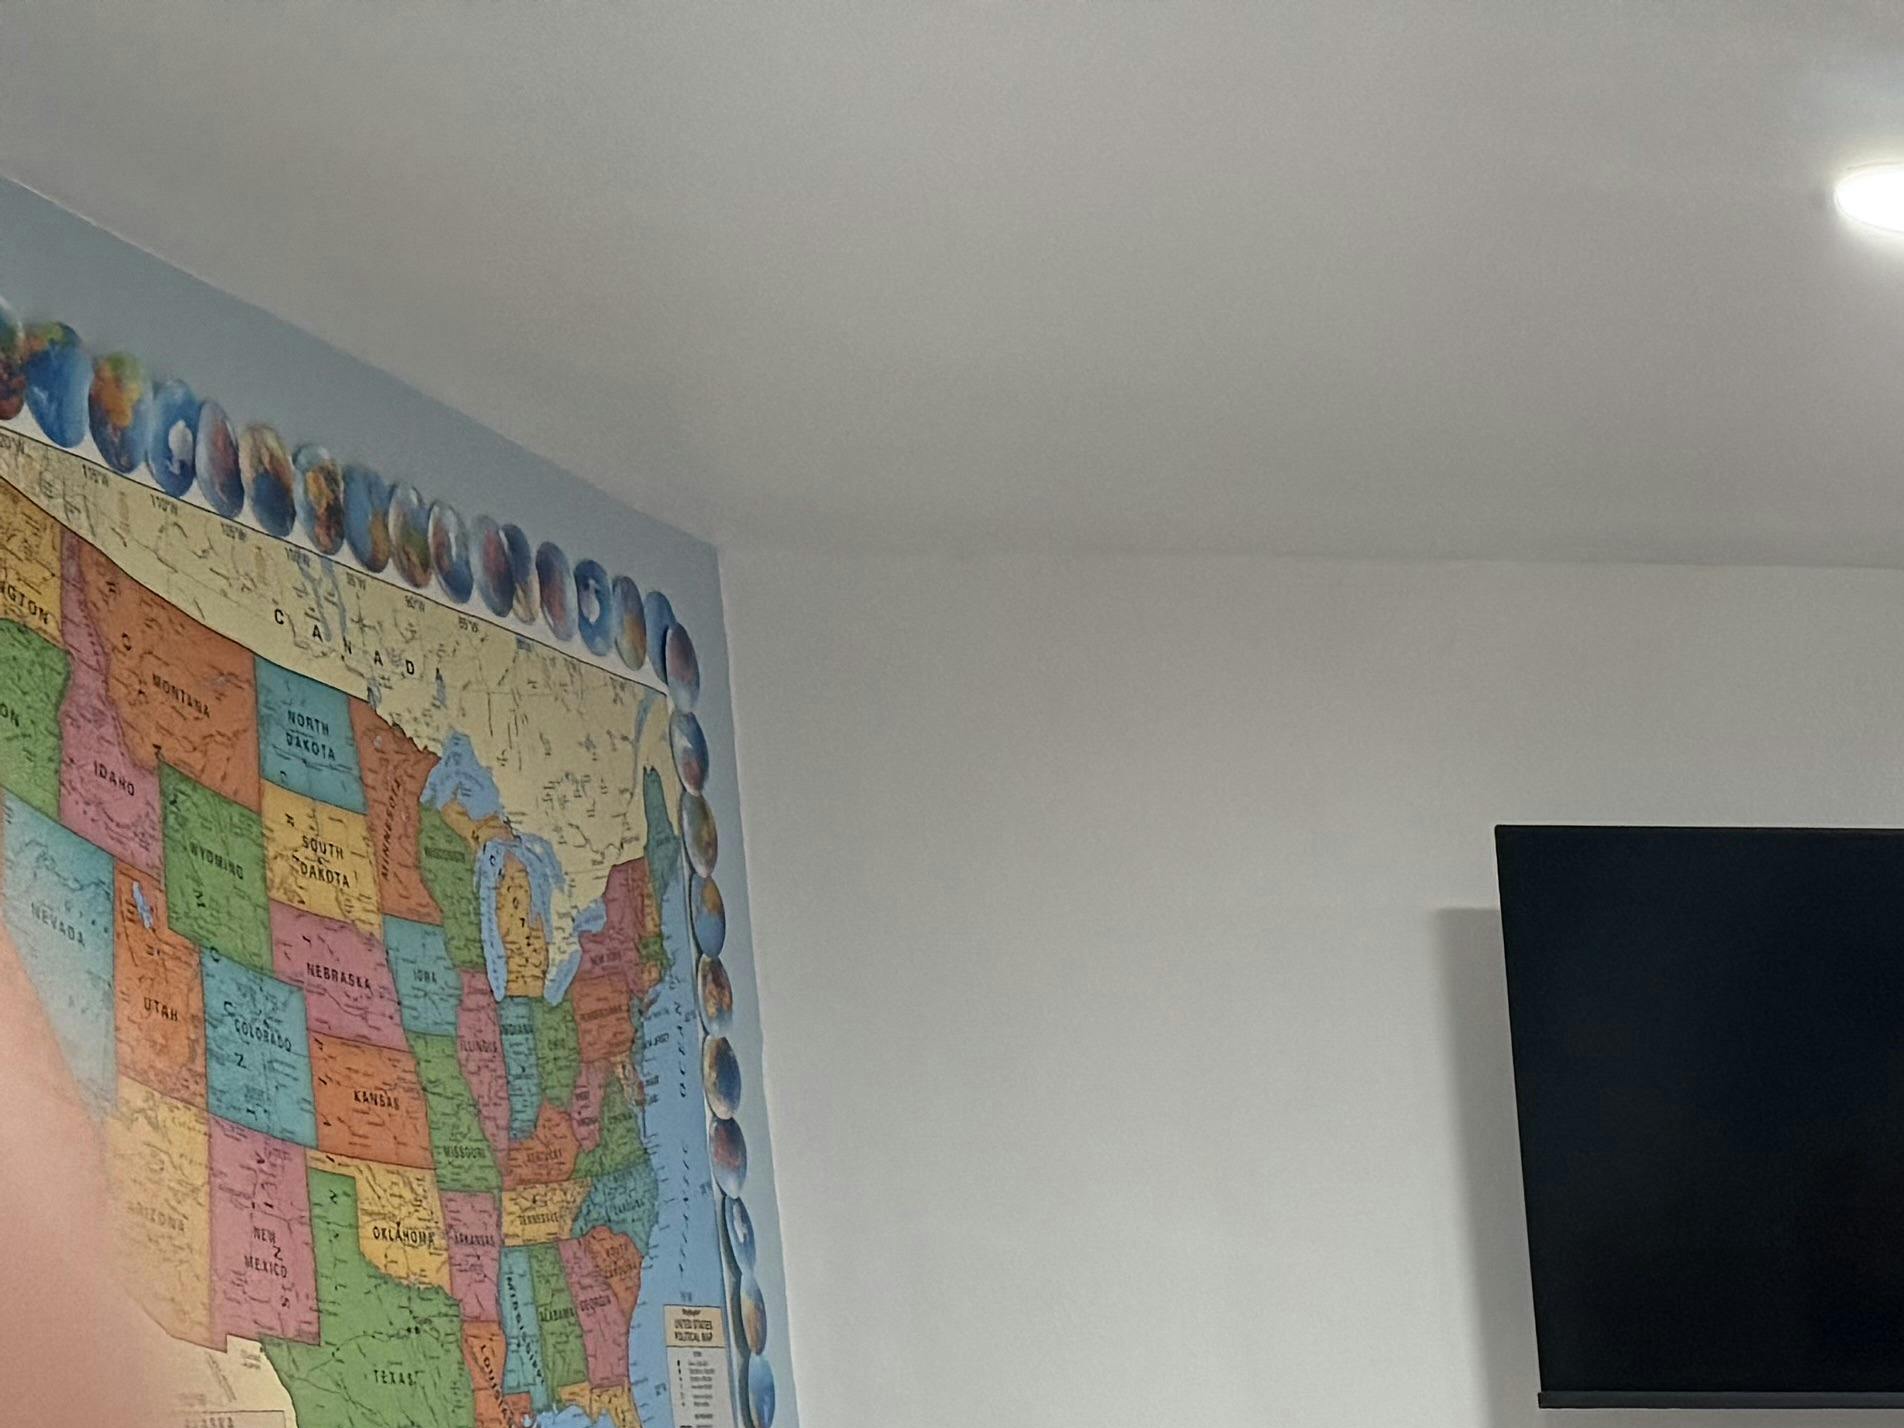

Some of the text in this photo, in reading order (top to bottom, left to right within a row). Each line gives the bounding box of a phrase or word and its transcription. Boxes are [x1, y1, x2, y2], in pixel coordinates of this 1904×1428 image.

[151, 673, 212, 720] MONTANA
[287, 710, 330, 737] NORTH
[285, 732, 336, 762] DAKOTA
[93, 760, 136, 797] IDAHO
[189, 841, 245, 881] WYOMING
[301, 835, 345, 860] SOUTH
[300, 864, 351, 888] DAKOTA
[31, 902, 87, 948] NEVADA
[306, 963, 373, 991] NEBRASKA
[143, 998, 179, 1023] UTAH
[234, 1018, 293, 1053] COLORADO
[352, 1088, 401, 1111] KANSAS
[252, 1225, 278, 1245] NEW
[372, 1225, 436, 1246] OKLAHOMA
[243, 1253, 288, 1280] MEXICO
[372, 1369, 416, 1387] TEXAS
